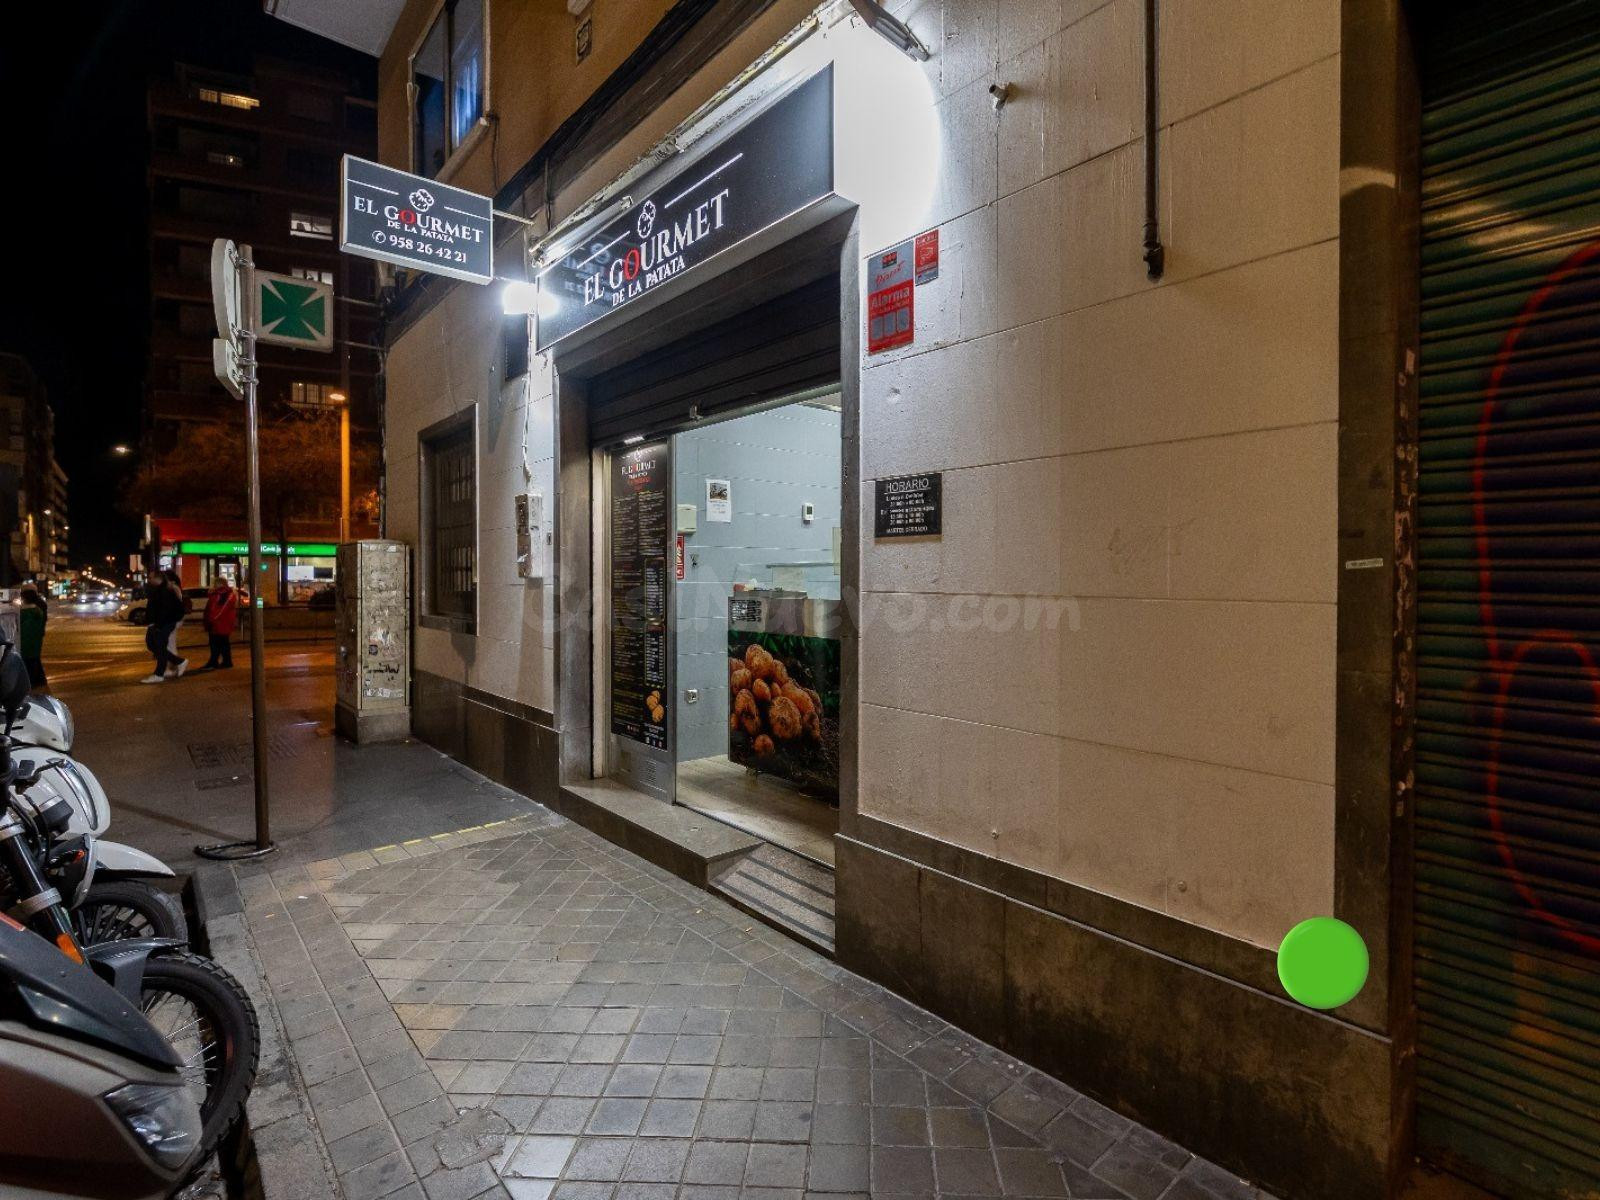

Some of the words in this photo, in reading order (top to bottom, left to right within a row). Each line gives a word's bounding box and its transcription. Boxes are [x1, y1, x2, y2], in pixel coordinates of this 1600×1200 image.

[354, 196, 378, 215] EL
[384, 205, 484, 243] GOURMET
[388, 220, 400, 229] DE
[404, 224, 417, 234] LA
[421, 229, 454, 244] PATATA
[389, 235, 414, 249] 958
[416, 241, 433, 255] 26
[436, 248, 452, 260] 42
[454, 252, 467, 263] 21
[584, 272, 605, 306] EL
[609, 188, 729, 290] GOURMET
[612, 288, 625, 306] DE
[629, 280, 642, 297] LA
[646, 255, 686, 289] PATATA
[871, 287, 910, 308] Alarma
[887, 478, 929, 492] HORARIO
